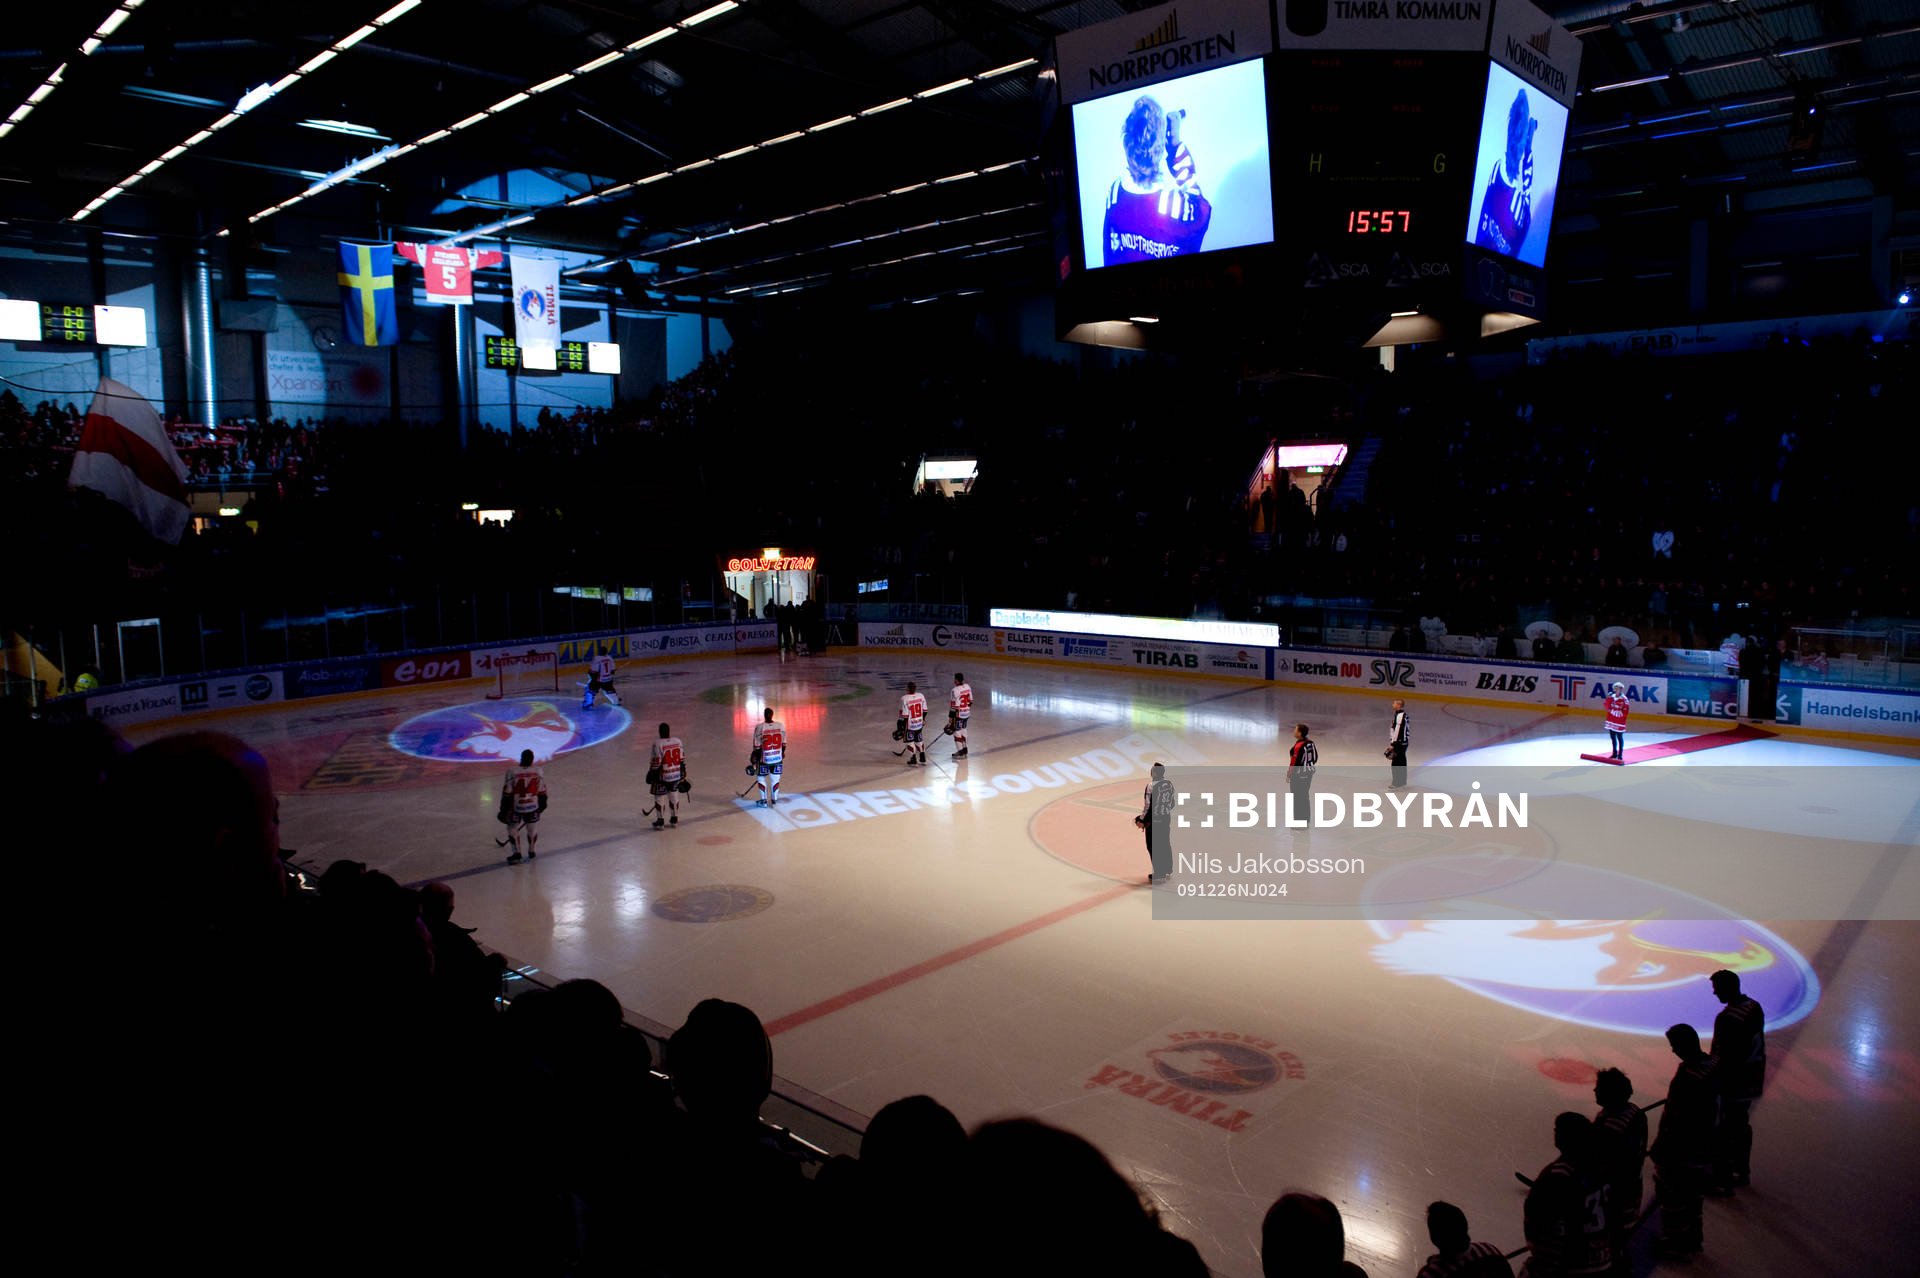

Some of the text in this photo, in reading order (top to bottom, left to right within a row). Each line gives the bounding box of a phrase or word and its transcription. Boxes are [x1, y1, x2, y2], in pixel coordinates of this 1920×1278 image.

[1396, 1, 1481, 20] KOMMUN
[1089, 30, 1235, 90] NORRPORTEN
[1505, 35, 1568, 96] NORRPORTEN
[1432, 152, 1447, 175] G
[1347, 210, 1411, 233] 15:57
[442, 265, 457, 289] 5
[1339, 263, 1370, 276] SCA
[1420, 263, 1450, 276] SCA
[865, 636, 924, 647] NORRPORTEN
[1132, 649, 1199, 668] TIRAB
[1475, 672, 1539, 694] BAES
[762, 733, 782, 751] 29
[514, 777, 538, 797] 44
